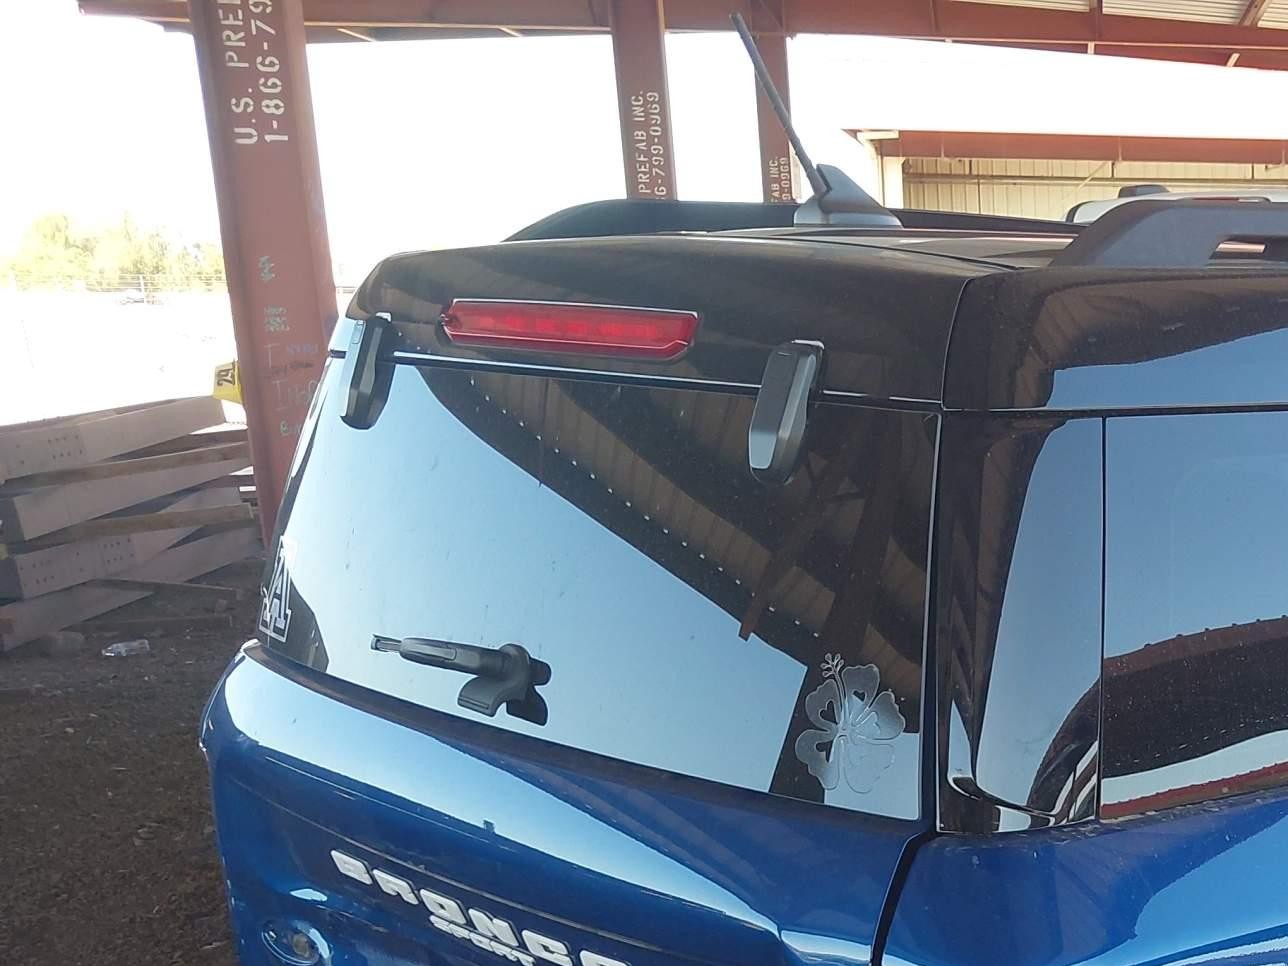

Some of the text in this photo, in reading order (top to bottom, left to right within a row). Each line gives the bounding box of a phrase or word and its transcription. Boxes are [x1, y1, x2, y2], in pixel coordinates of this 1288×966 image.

[217, 0, 258, 145] U.S. PRE
[631, 90, 651, 194] PREFAB INC.
[646, 91, 667, 200] 6-799-0969
[769, 156, 780, 178] INC.
